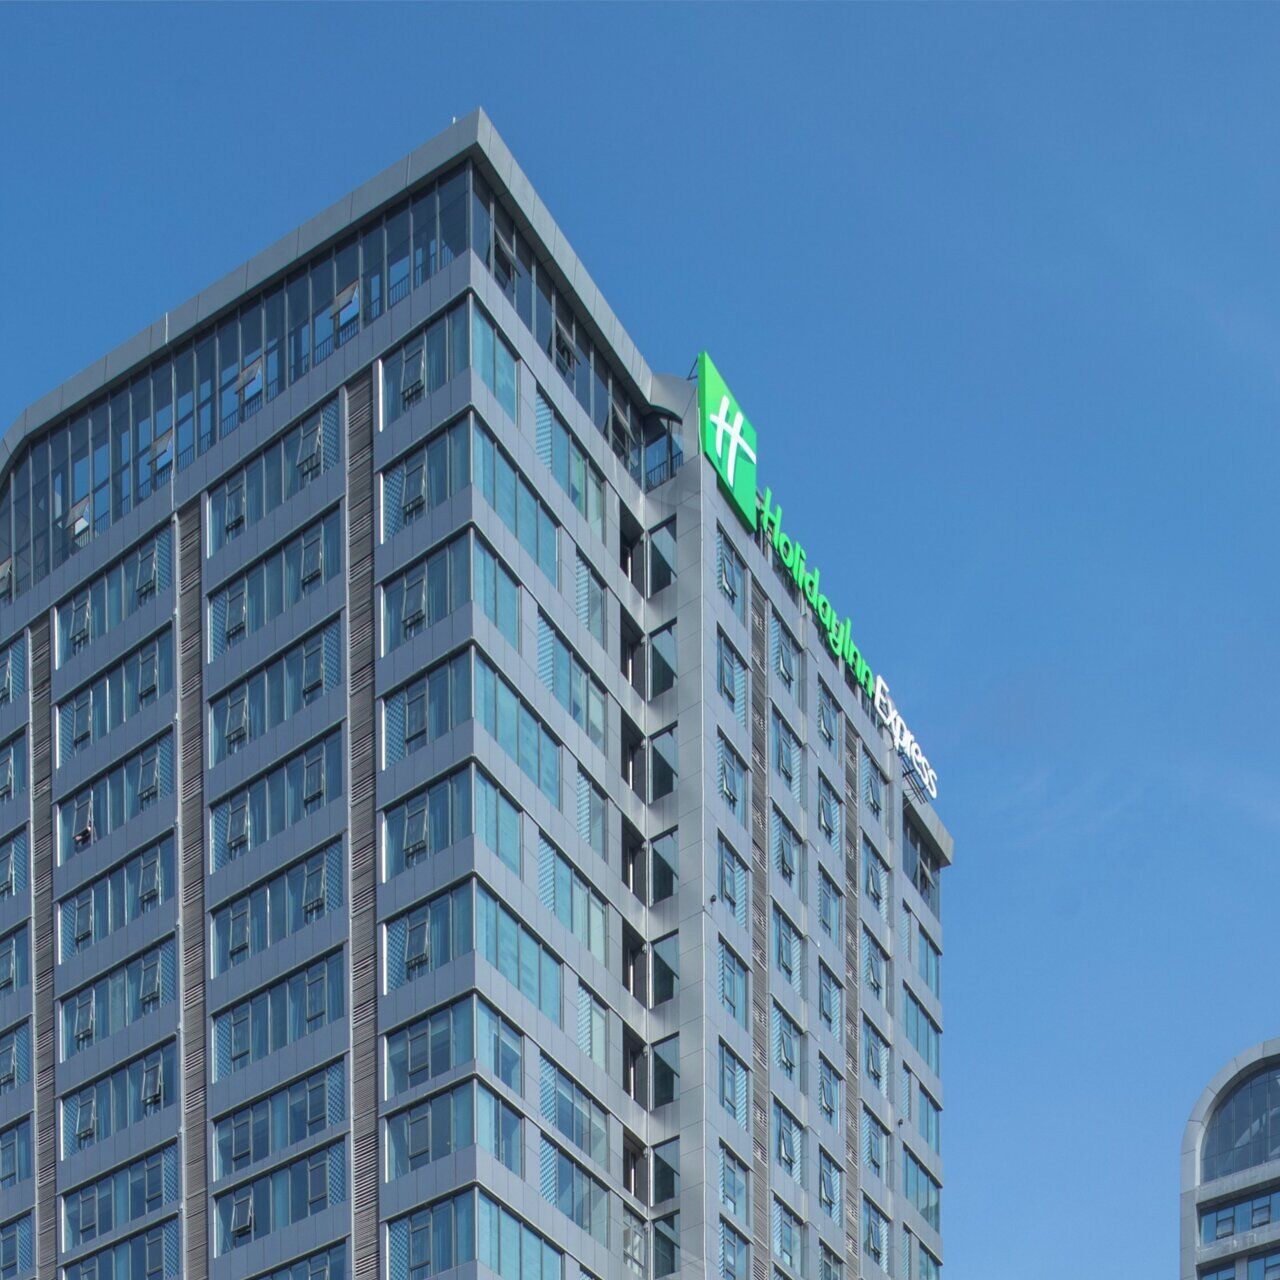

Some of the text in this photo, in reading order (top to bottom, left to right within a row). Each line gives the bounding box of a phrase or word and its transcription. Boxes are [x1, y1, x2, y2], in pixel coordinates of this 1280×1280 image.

[761, 486, 938, 799] Holiday Inn Express
